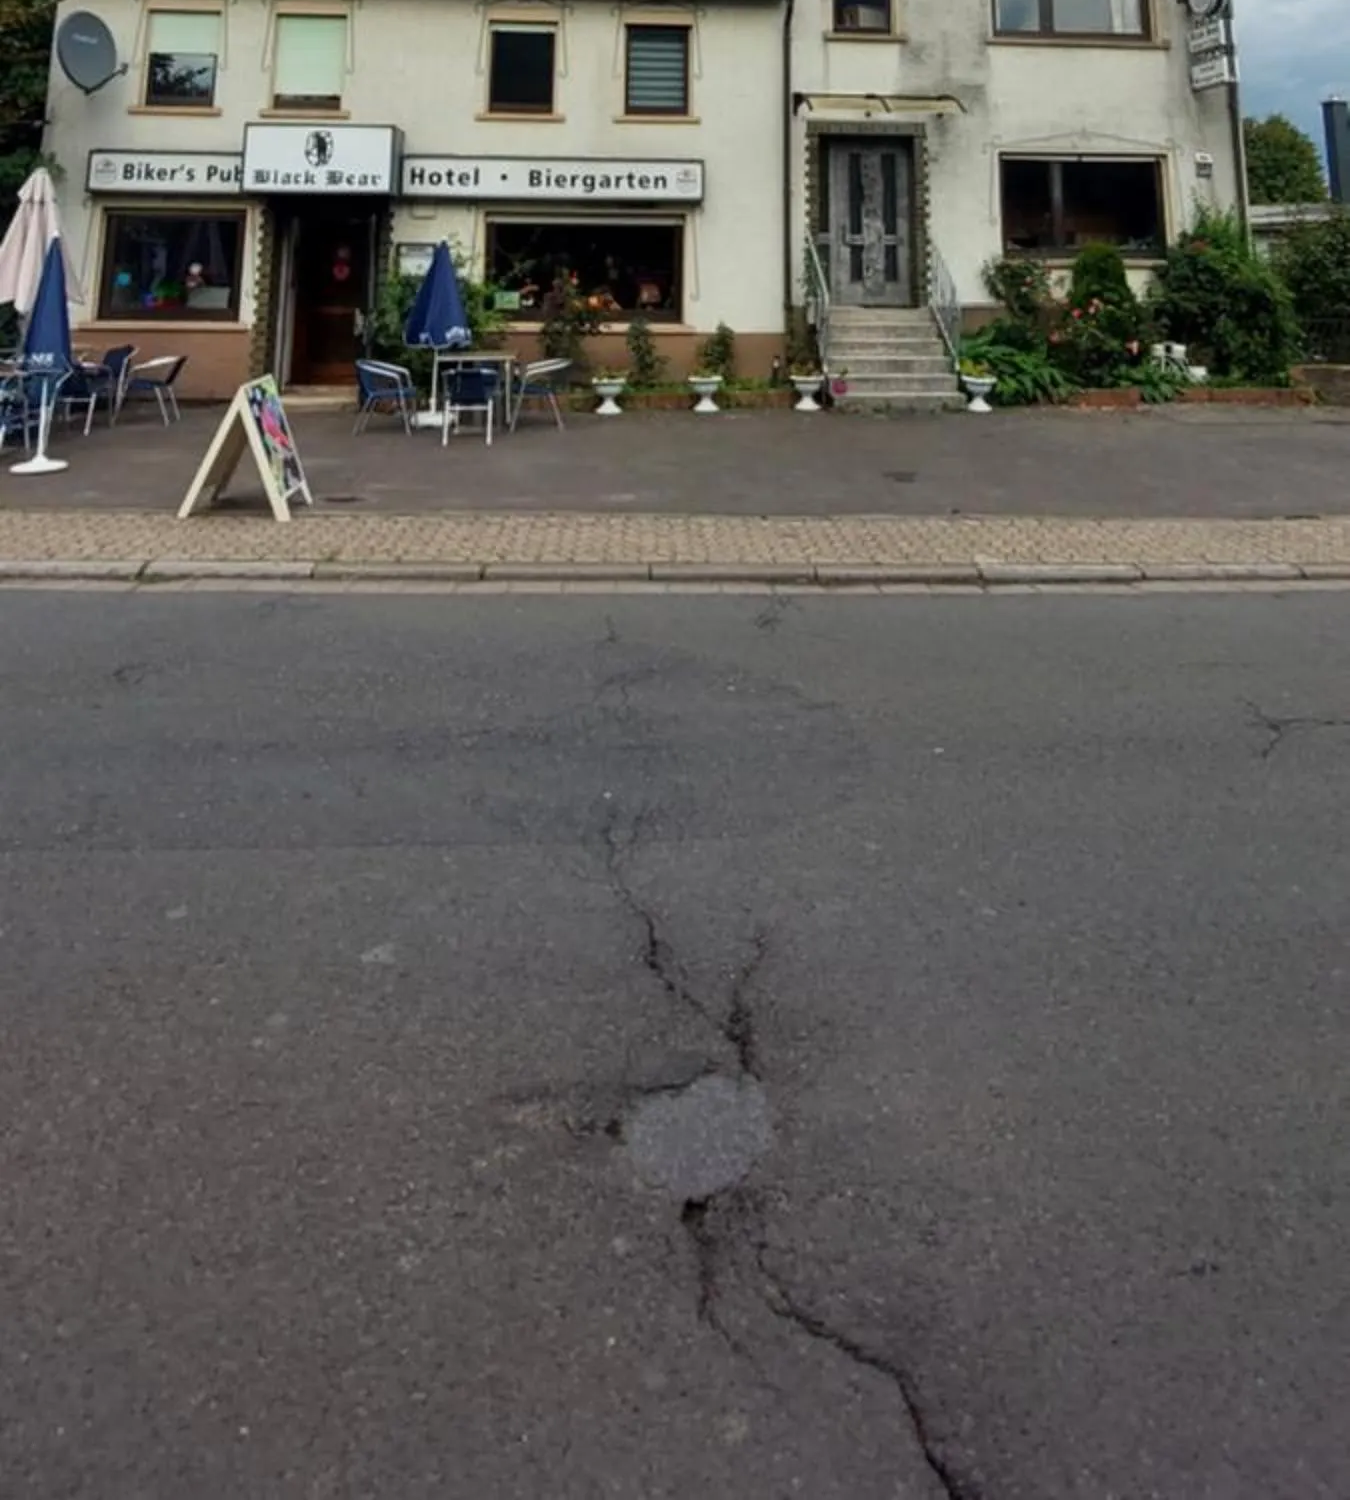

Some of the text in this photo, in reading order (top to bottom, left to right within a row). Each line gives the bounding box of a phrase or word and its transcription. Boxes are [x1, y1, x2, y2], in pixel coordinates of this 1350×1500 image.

[122, 162, 195, 181] Biker's
[253, 169, 381, 186] Black Bear
[409, 167, 668, 192] Hotel Biergarten
